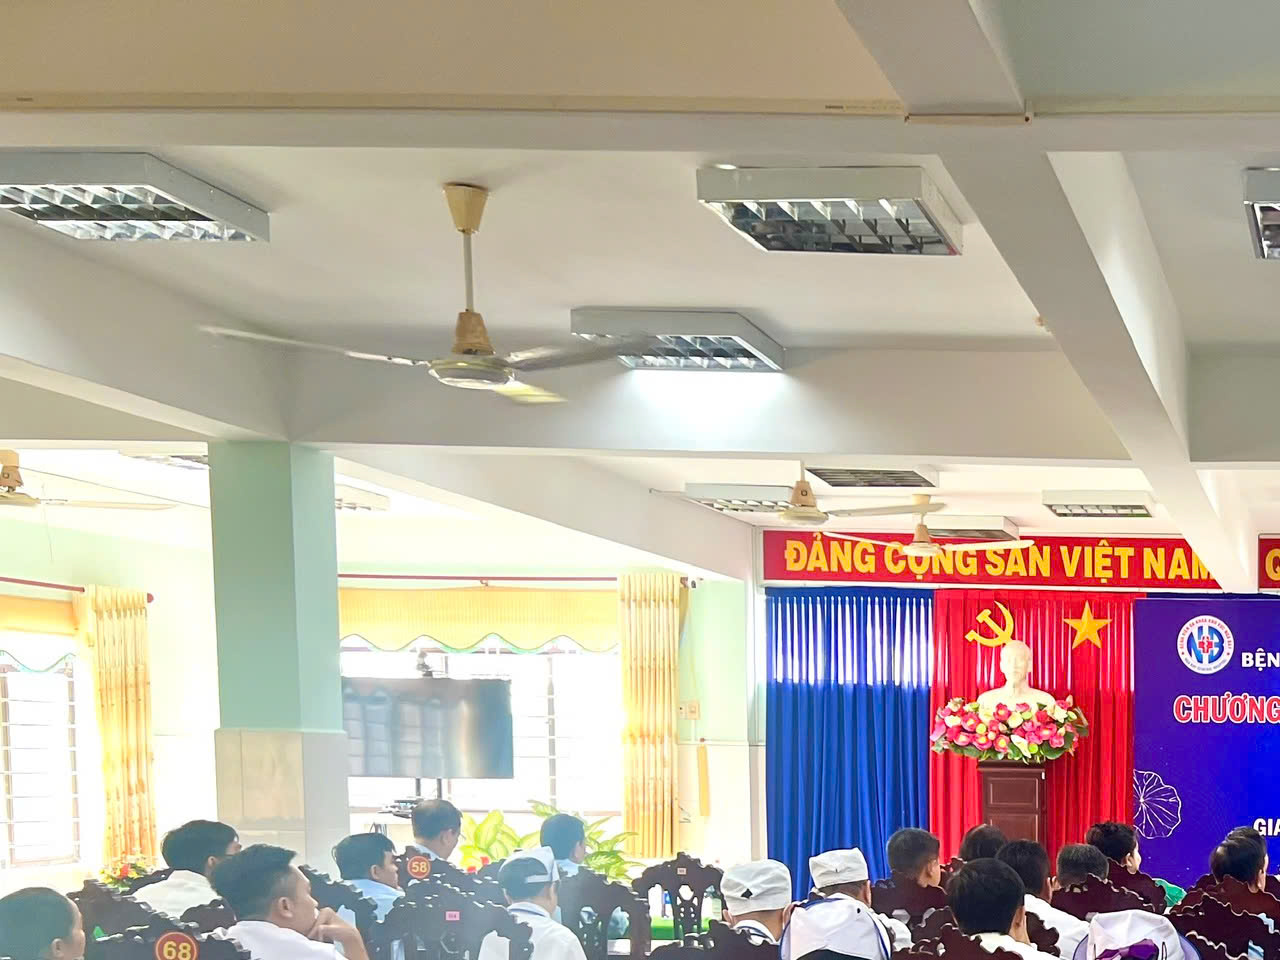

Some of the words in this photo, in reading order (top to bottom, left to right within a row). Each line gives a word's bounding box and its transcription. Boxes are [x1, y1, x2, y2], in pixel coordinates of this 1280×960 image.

[784, 532, 876, 573] ĐẢNG
[1060, 539, 1134, 583] VIỆT
[412, 861, 427, 873] 58
